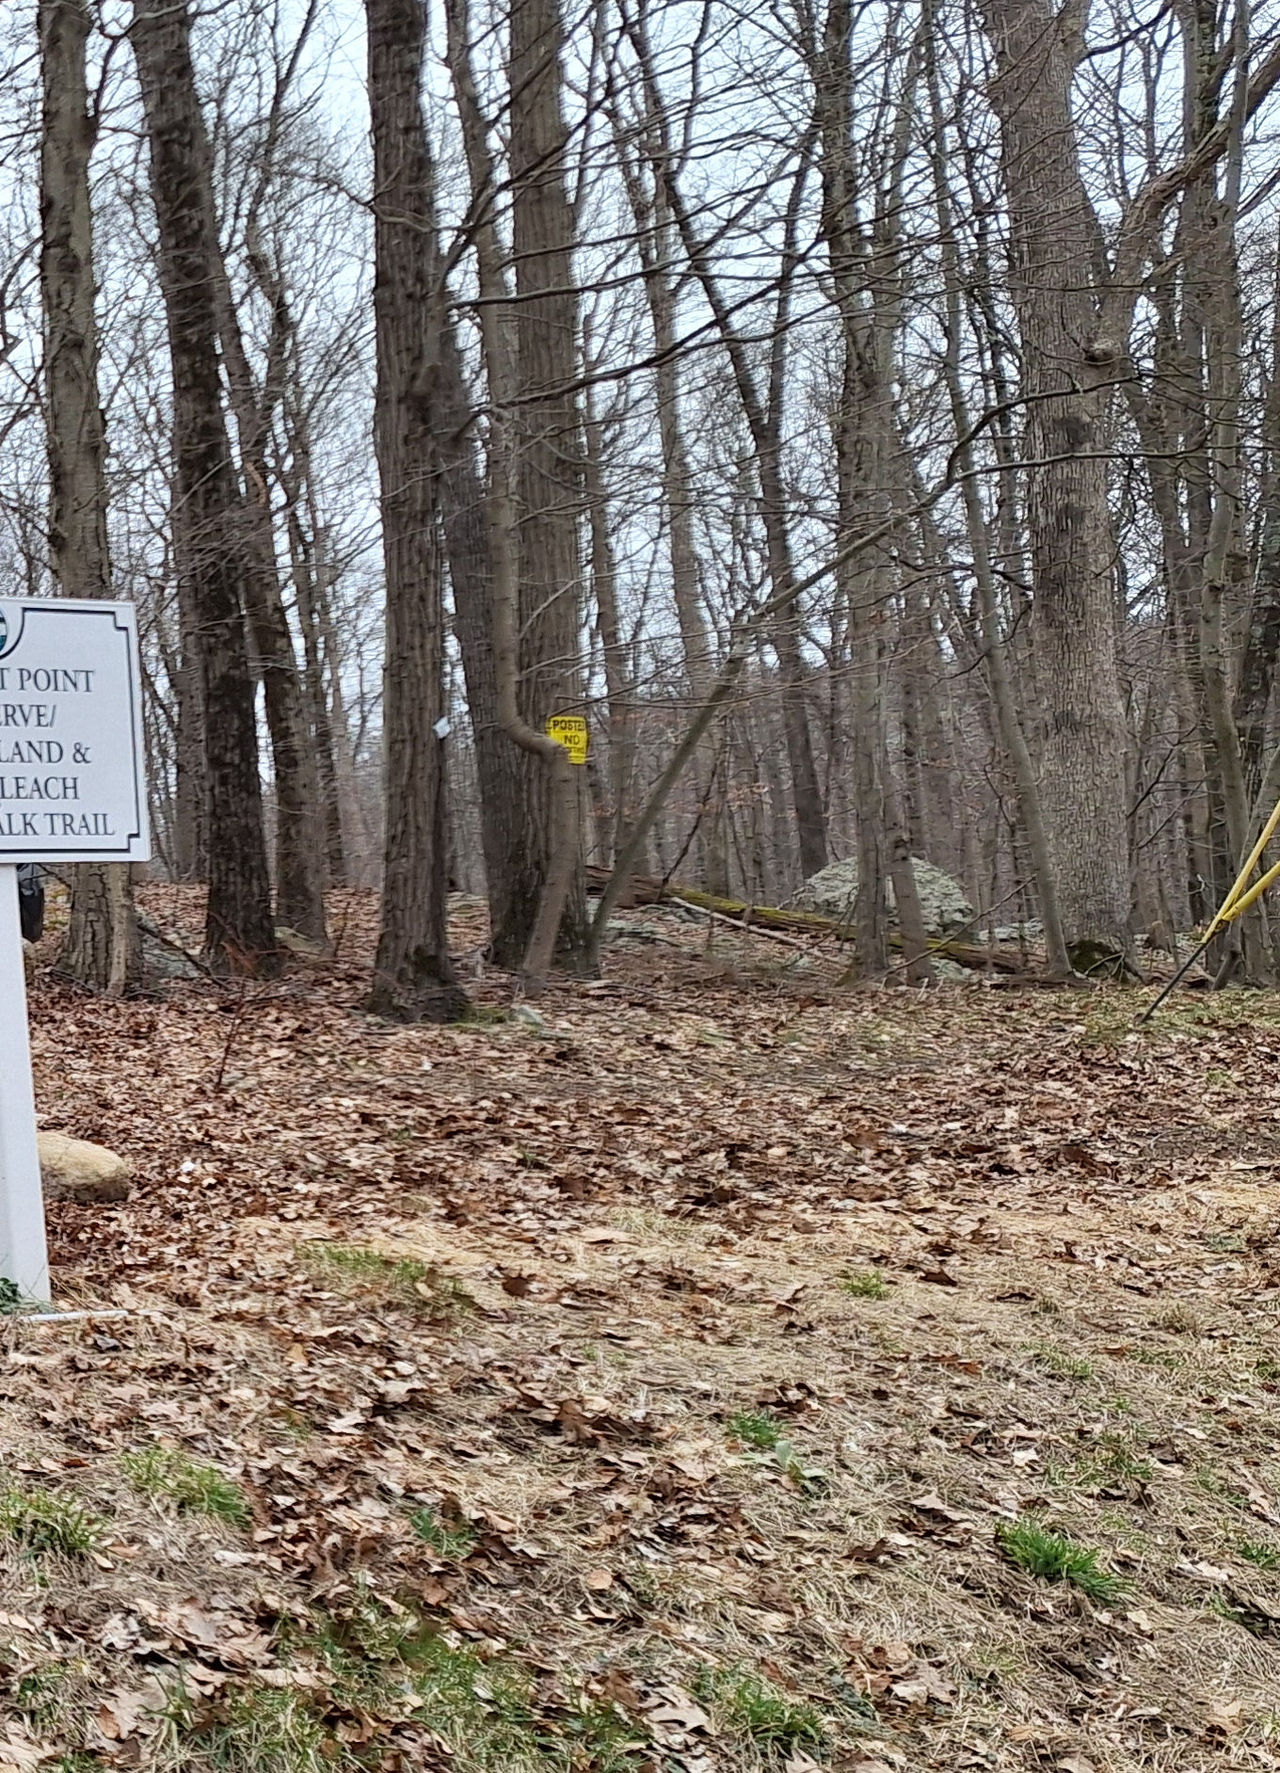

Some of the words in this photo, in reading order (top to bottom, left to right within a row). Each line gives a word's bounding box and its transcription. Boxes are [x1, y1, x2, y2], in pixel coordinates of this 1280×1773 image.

[17, 668, 95, 693] POINT
[72, 743, 92, 764] &
[0, 776, 80, 800] LEACH
[44, 813, 115, 837] TRAIL
